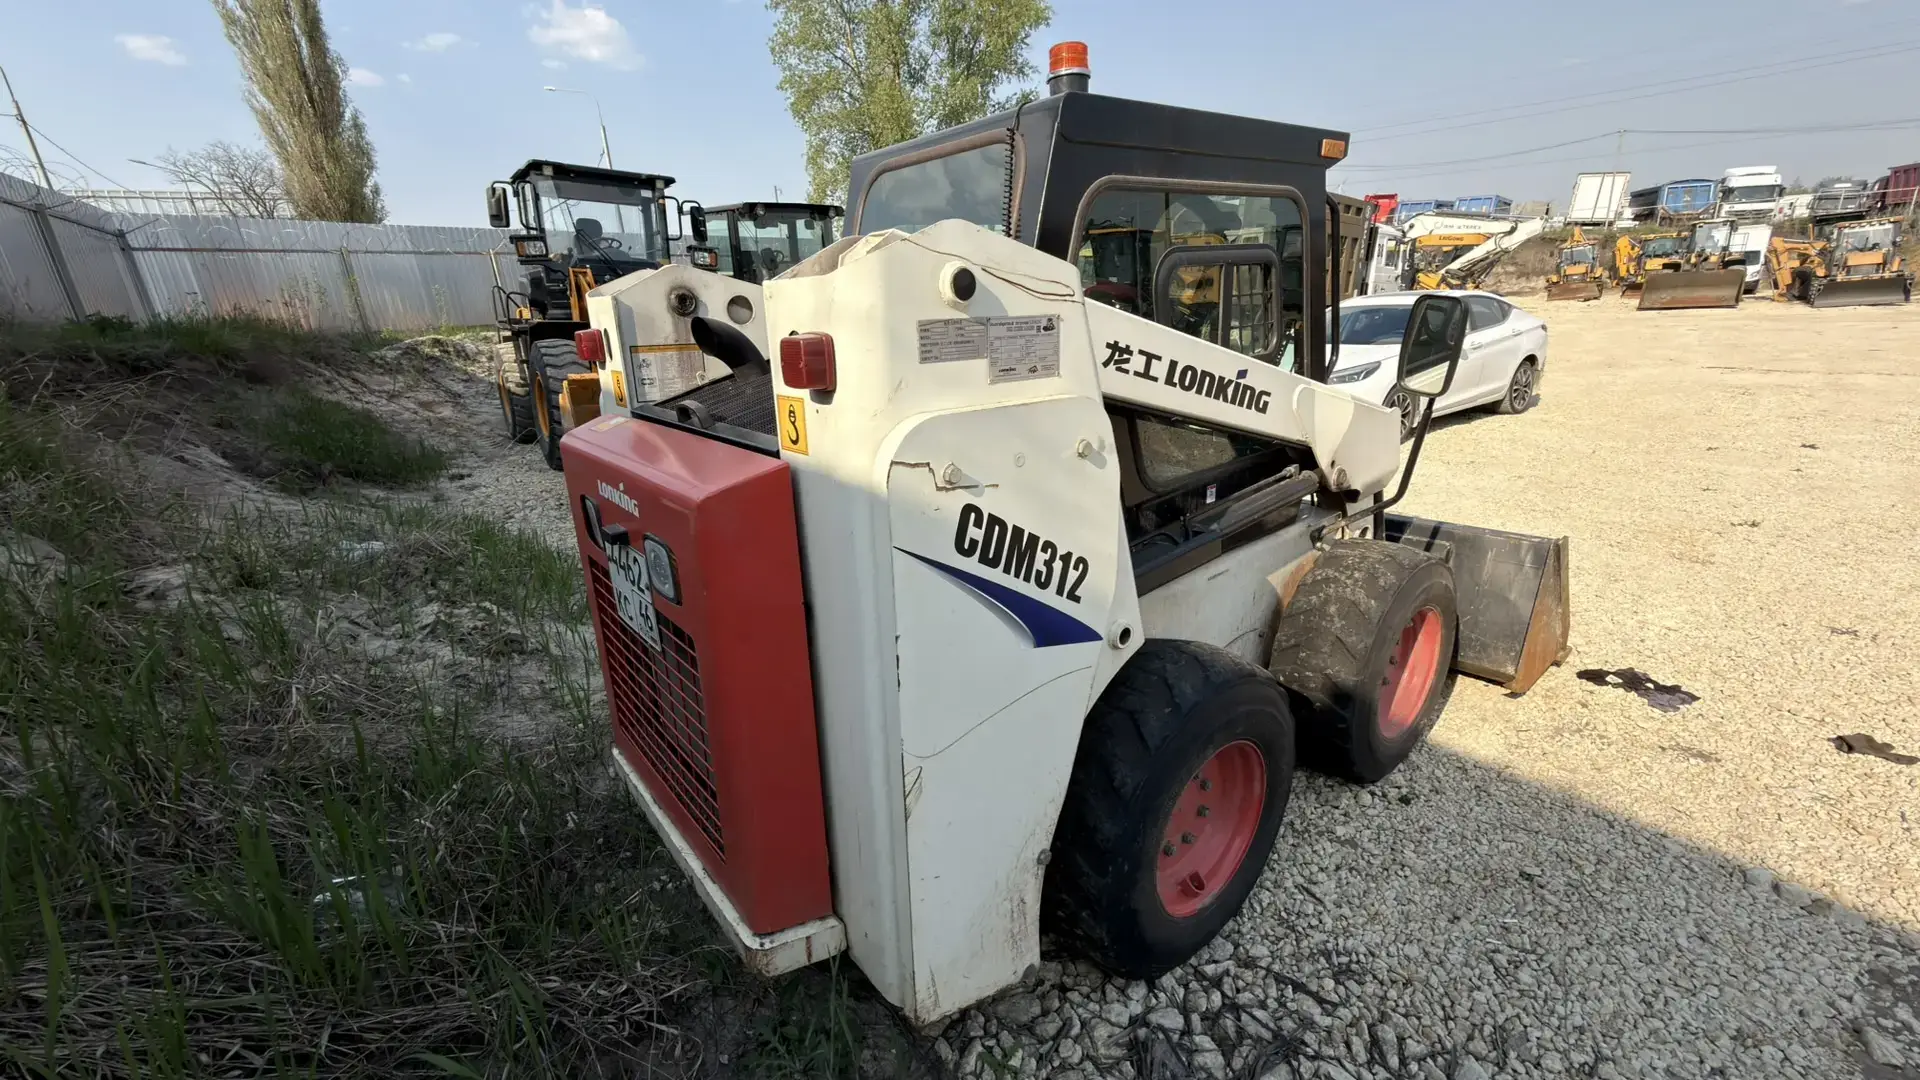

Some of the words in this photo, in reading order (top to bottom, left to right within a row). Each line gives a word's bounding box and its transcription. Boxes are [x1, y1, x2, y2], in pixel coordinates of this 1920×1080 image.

[1101, 340, 1162, 383] 龙工
[611, 545, 646, 596] 4462
[954, 502, 1090, 604] CDM312
[639, 598, 654, 633] 46
